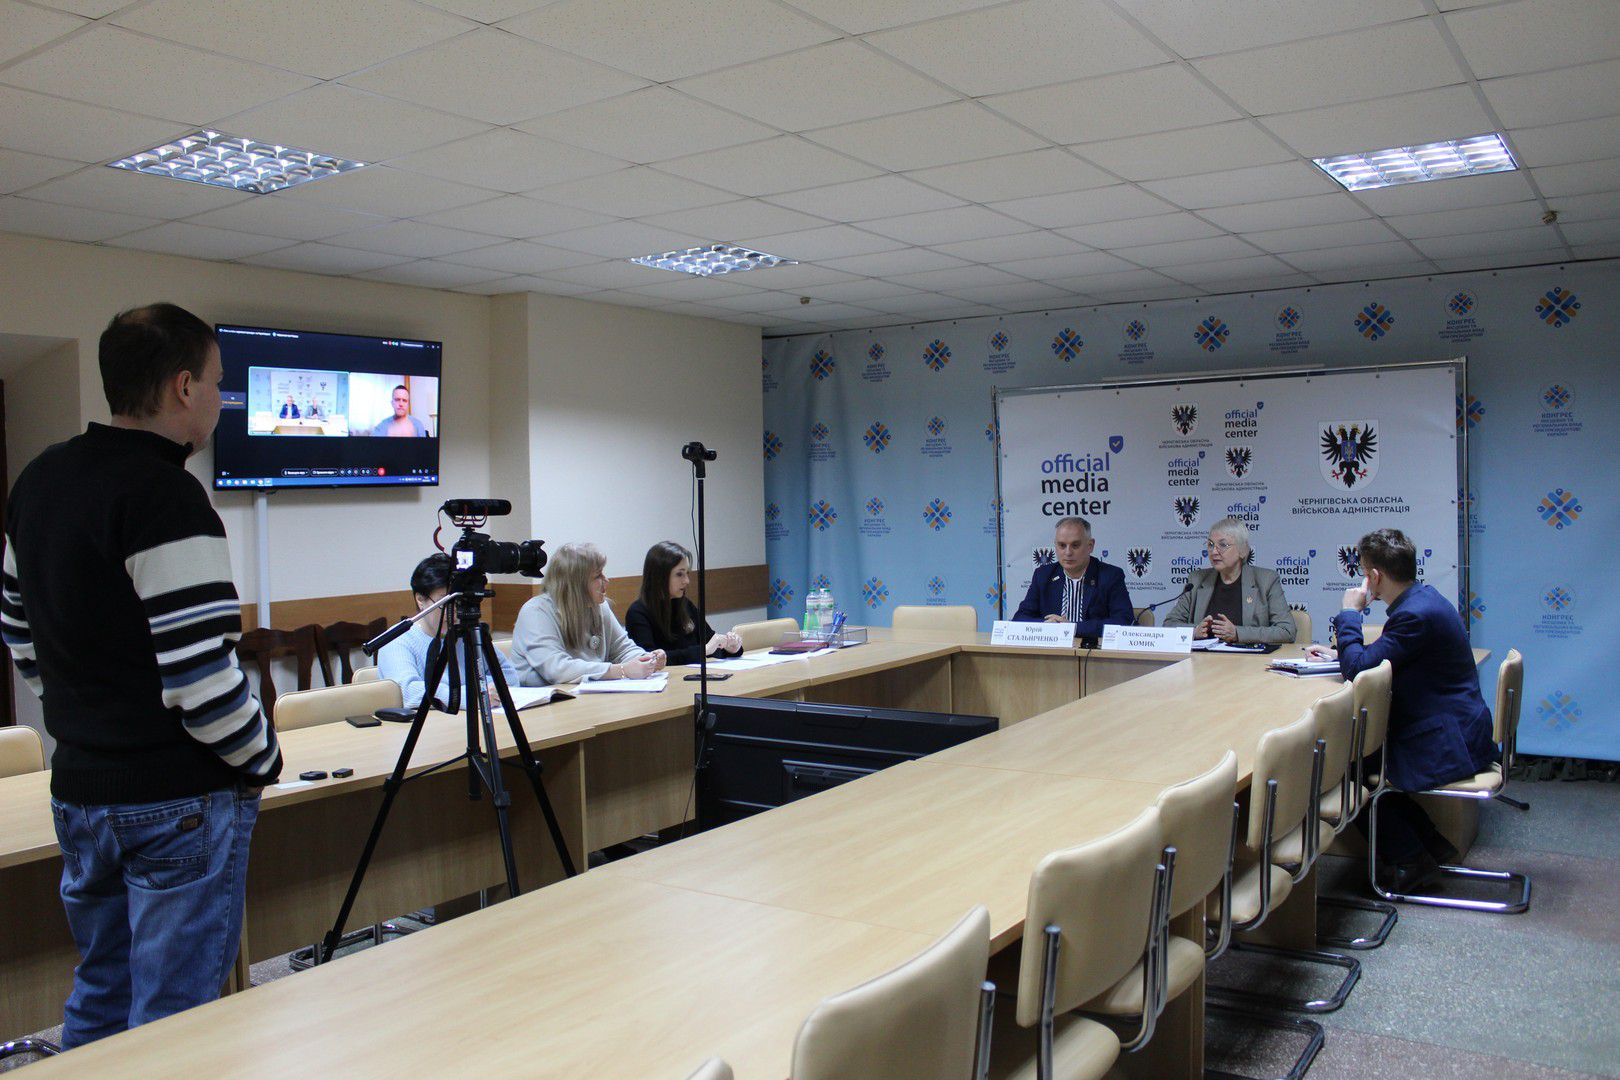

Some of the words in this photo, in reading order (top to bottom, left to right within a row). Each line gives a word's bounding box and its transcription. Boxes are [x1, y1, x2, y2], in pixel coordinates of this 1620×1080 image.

[1225, 409, 1258, 419] official
[1225, 418, 1257, 428] media
[1225, 428, 1258, 439] center
[1041, 452, 1110, 474] official
[1167, 458, 1200, 468] official
[1168, 467, 1199, 477] media
[1041, 472, 1109, 494] media
[1168, 478, 1200, 487] center
[1298, 497, 1358, 505] ЧЕРНІГІВСЬКА
[1360, 496, 1403, 504] ОБЛАСНА
[1041, 498, 1111, 516] center
[1227, 503, 1260, 512] official
[1292, 506, 1340, 515] ВІЙСЬКОВА
[1342, 505, 1410, 514] АДМІНІСТРАЦІЯ
[1227, 512, 1259, 521] media
[1245, 523, 1260, 531] ter
[1171, 556, 1203, 566] official
[1276, 556, 1310, 566] official
[1276, 565, 1309, 575] media
[1171, 576, 1189, 584] cen
[1281, 577, 1310, 585] enter
[1122, 630, 1164, 639] Олександра
[1128, 639, 1156, 648] ХОМИК
